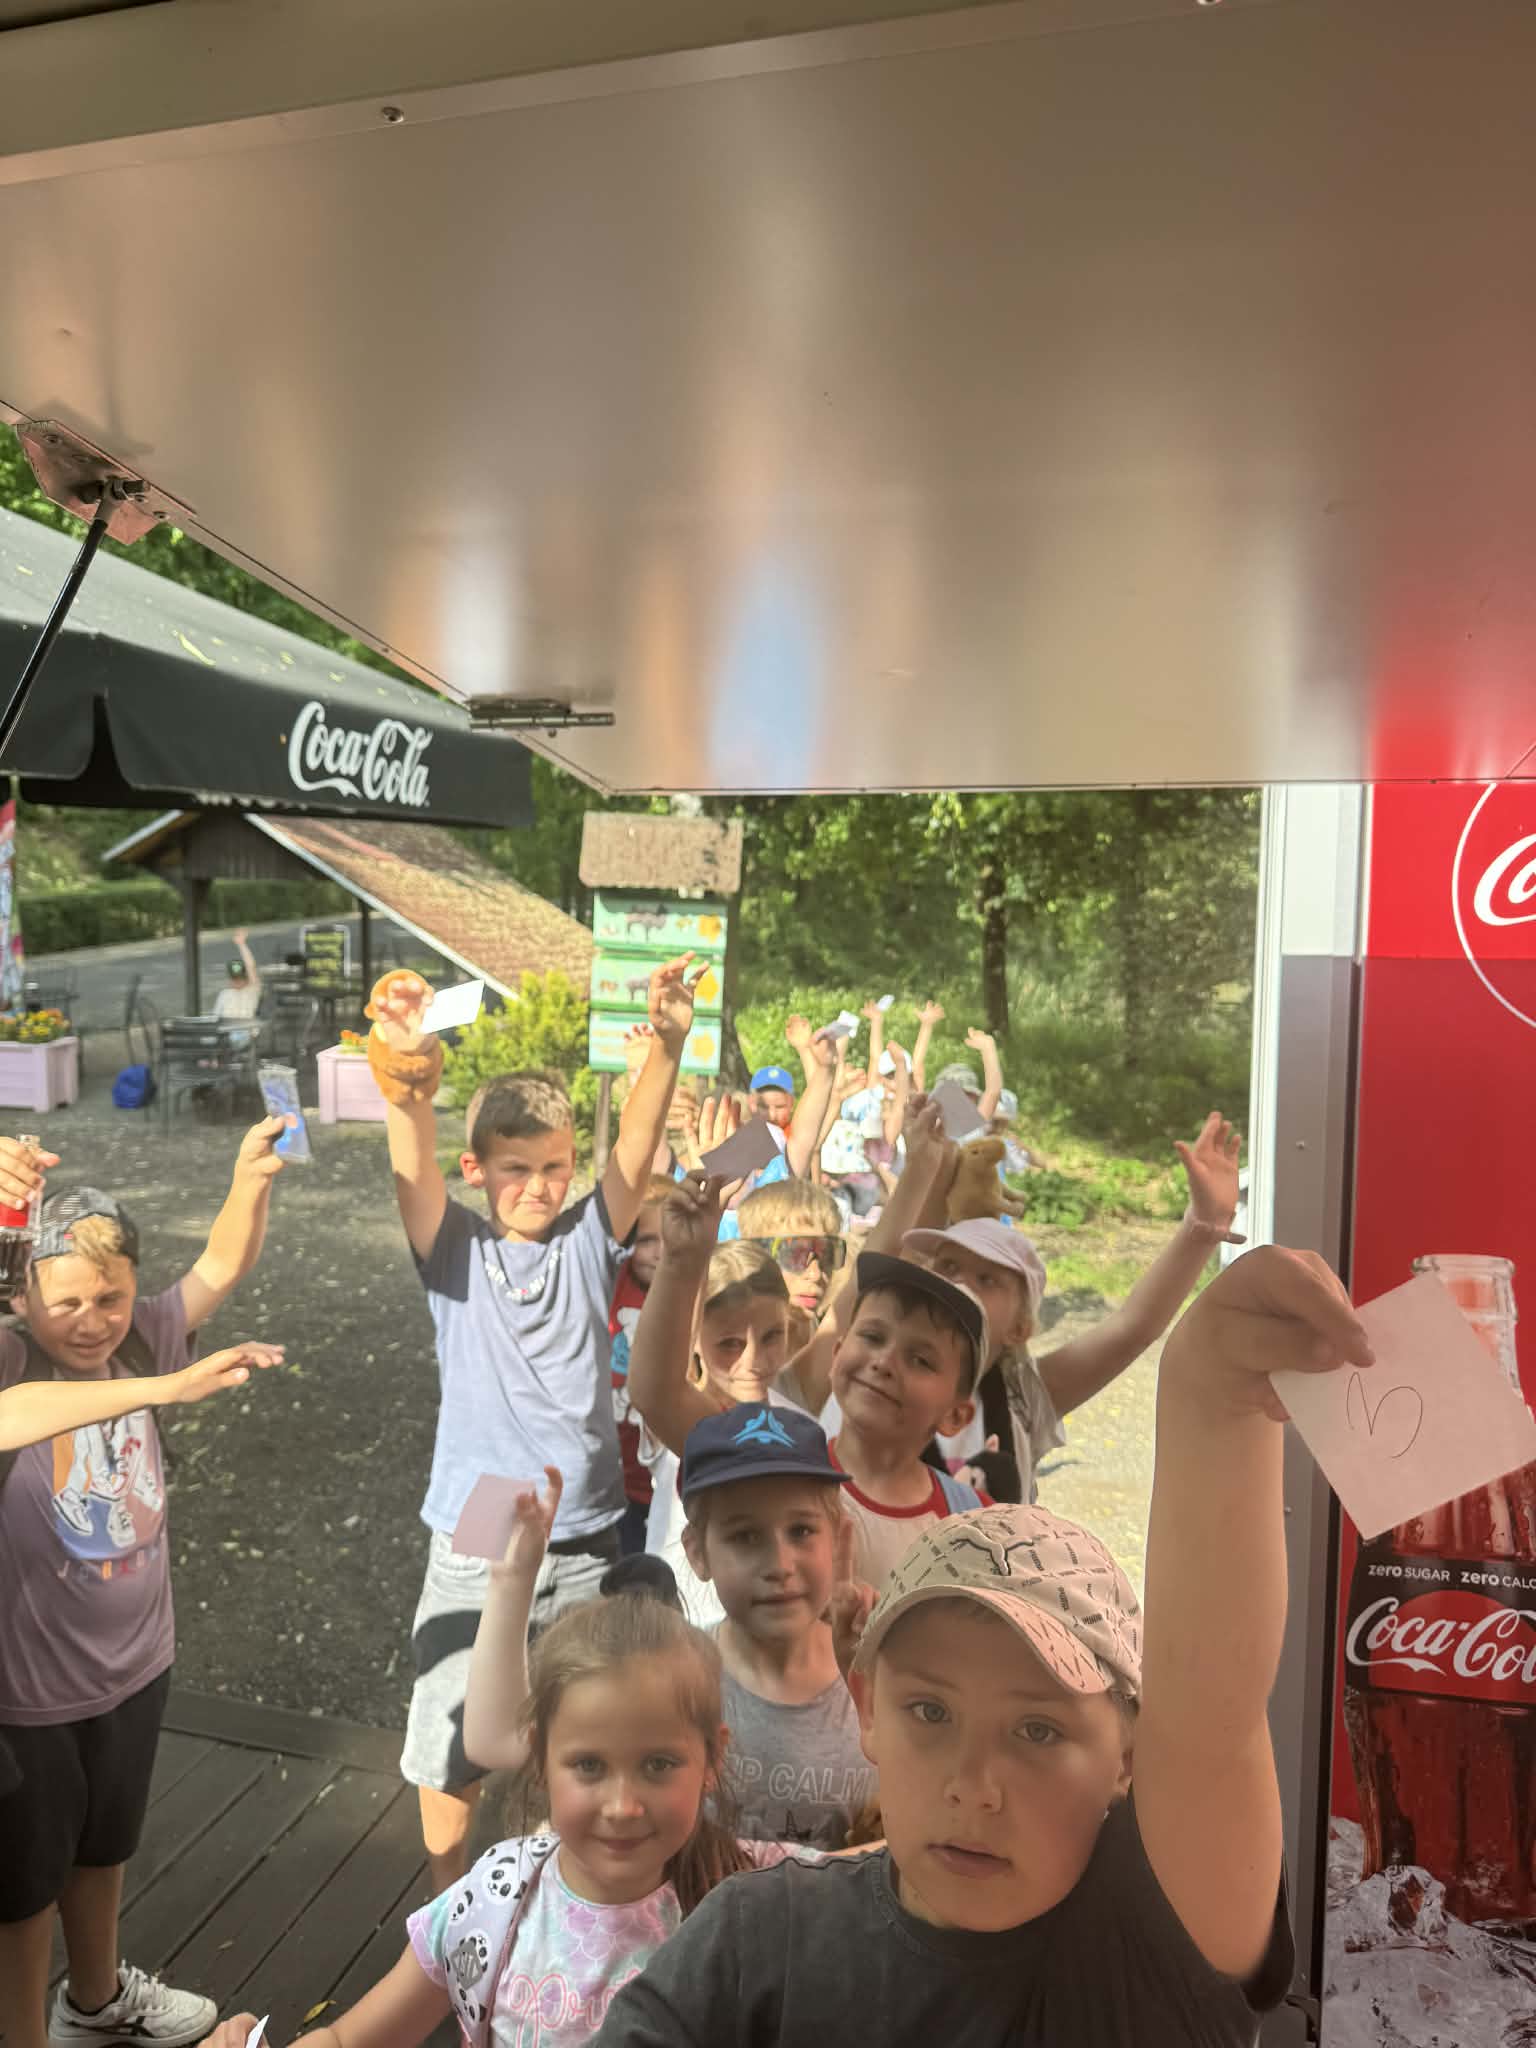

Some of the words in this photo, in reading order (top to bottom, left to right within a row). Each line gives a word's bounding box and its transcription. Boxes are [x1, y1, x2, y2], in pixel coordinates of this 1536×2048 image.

[288, 701, 433, 807] Coca-Cola
[1368, 1564, 1402, 1577] zero
[1404, 1566, 1450, 1582] SUGAR
[1460, 1571, 1499, 1586] zero
[768, 1763, 878, 1805] CALM
